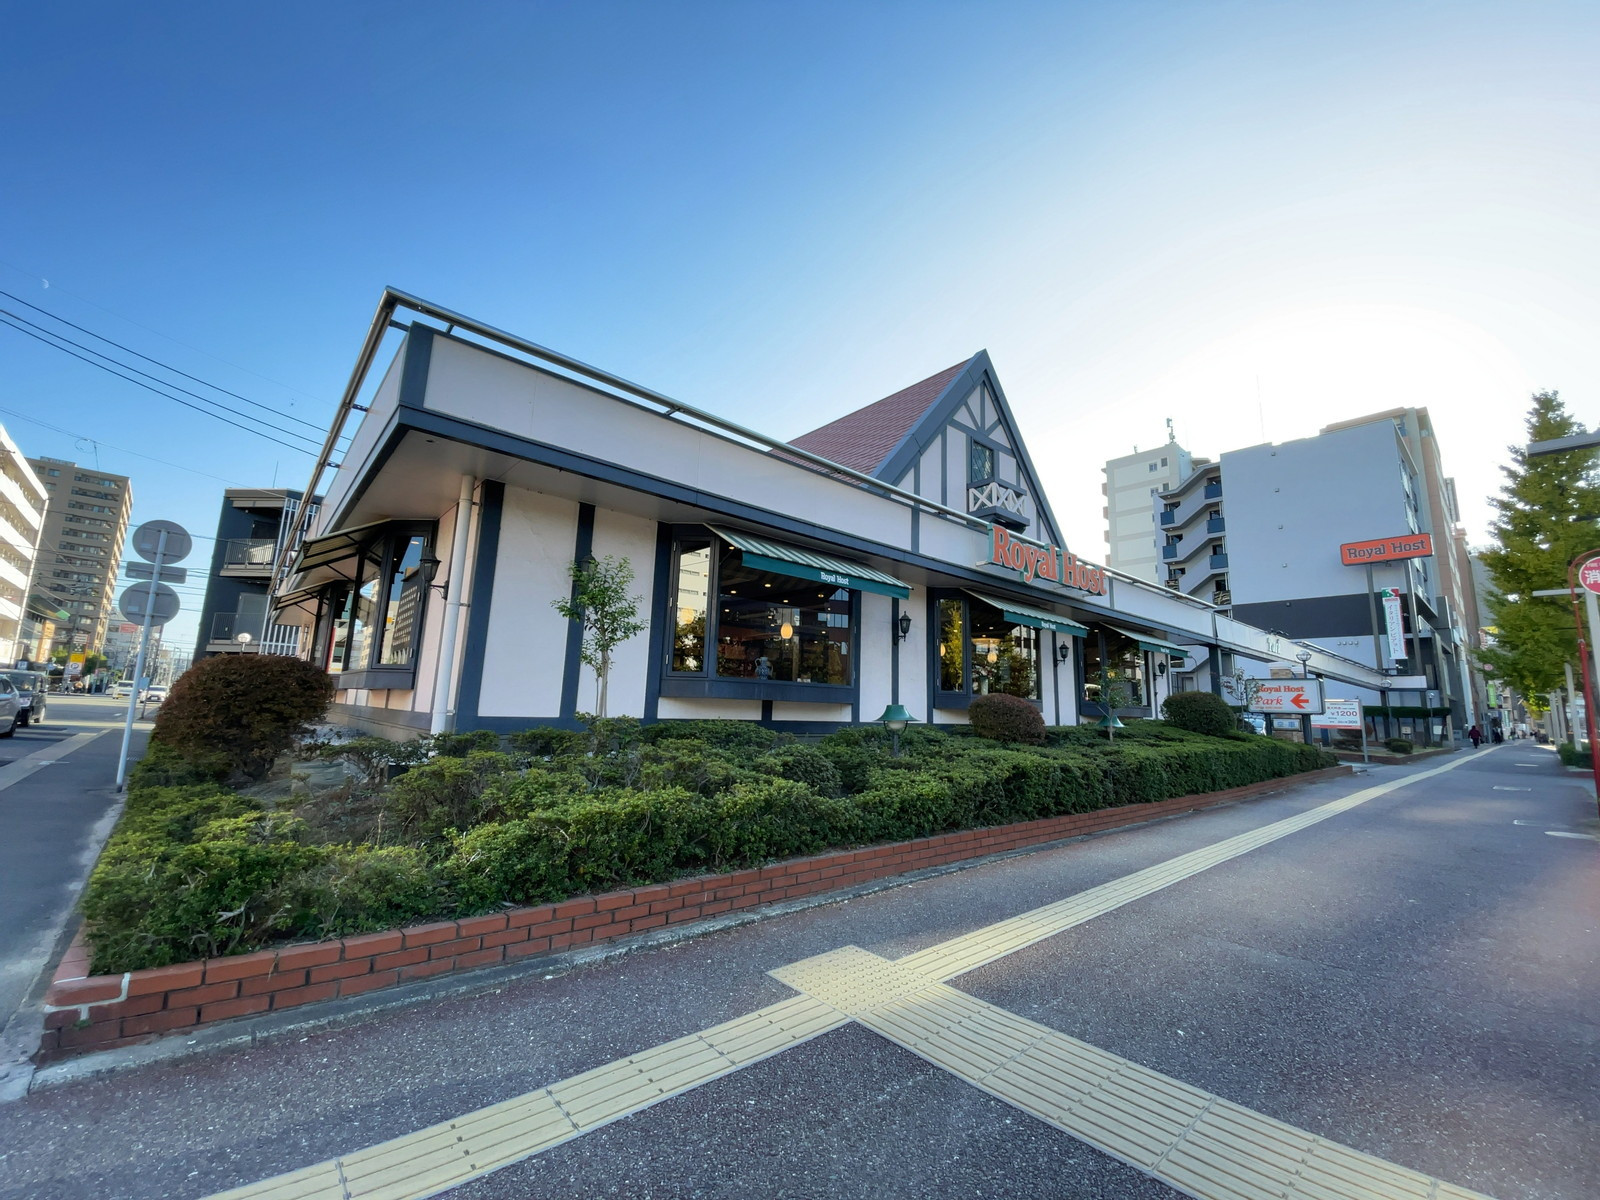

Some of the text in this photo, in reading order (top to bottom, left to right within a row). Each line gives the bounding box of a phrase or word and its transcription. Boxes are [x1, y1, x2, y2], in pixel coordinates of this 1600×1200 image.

[1346, 539, 1426, 559] Royal Host
[992, 524, 1107, 596] Royal Host
[820, 571, 849, 585] Royal Host
[1257, 685, 1305, 694] Royal Host
[1254, 695, 1283, 705] Park
